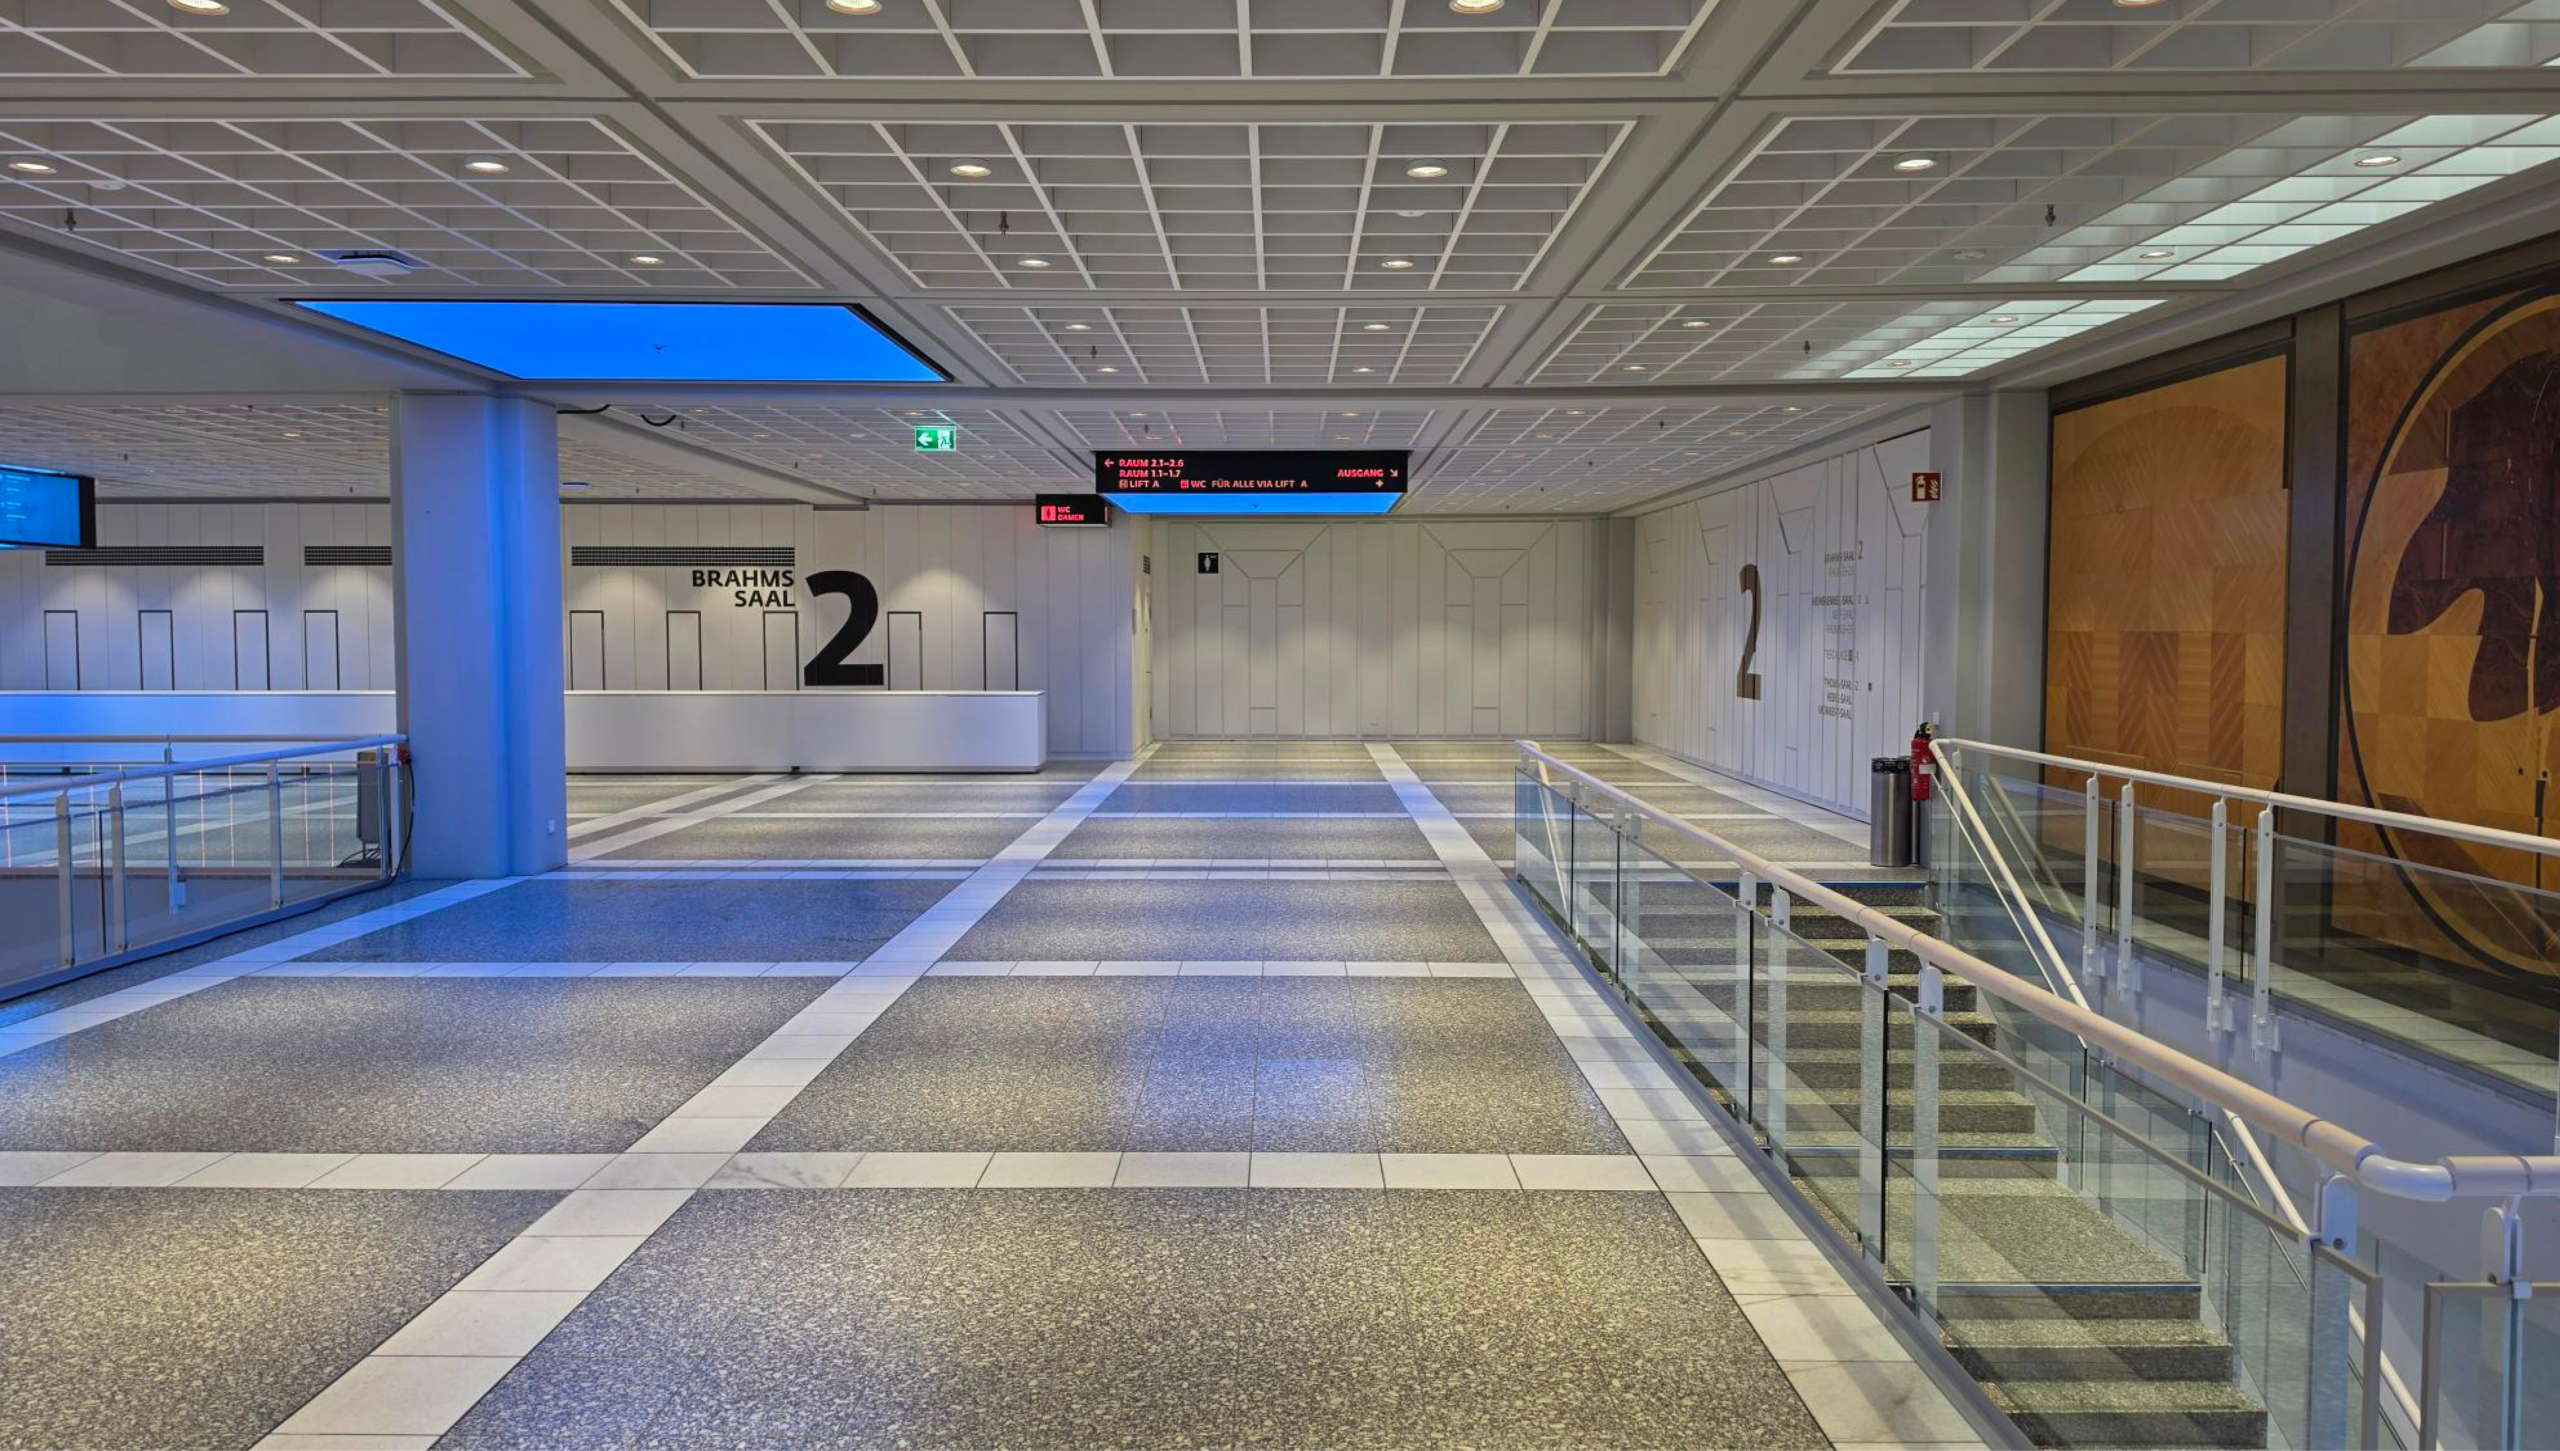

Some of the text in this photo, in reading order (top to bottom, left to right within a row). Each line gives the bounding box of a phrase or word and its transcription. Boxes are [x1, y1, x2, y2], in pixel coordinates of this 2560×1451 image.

[1119, 459, 1149, 467] RAUM
[1119, 469, 1149, 478] RAUM
[1337, 469, 1384, 477] AUSGANG
[1129, 480, 1160, 488] LIFT A
[1190, 477, 1308, 488] WC FÜR ALLE VIA LIFT A
[692, 570, 794, 587] BRAHMS
[734, 590, 795, 607] SAAL
[804, 570, 884, 686] 2
[1736, 564, 1763, 701] 2
